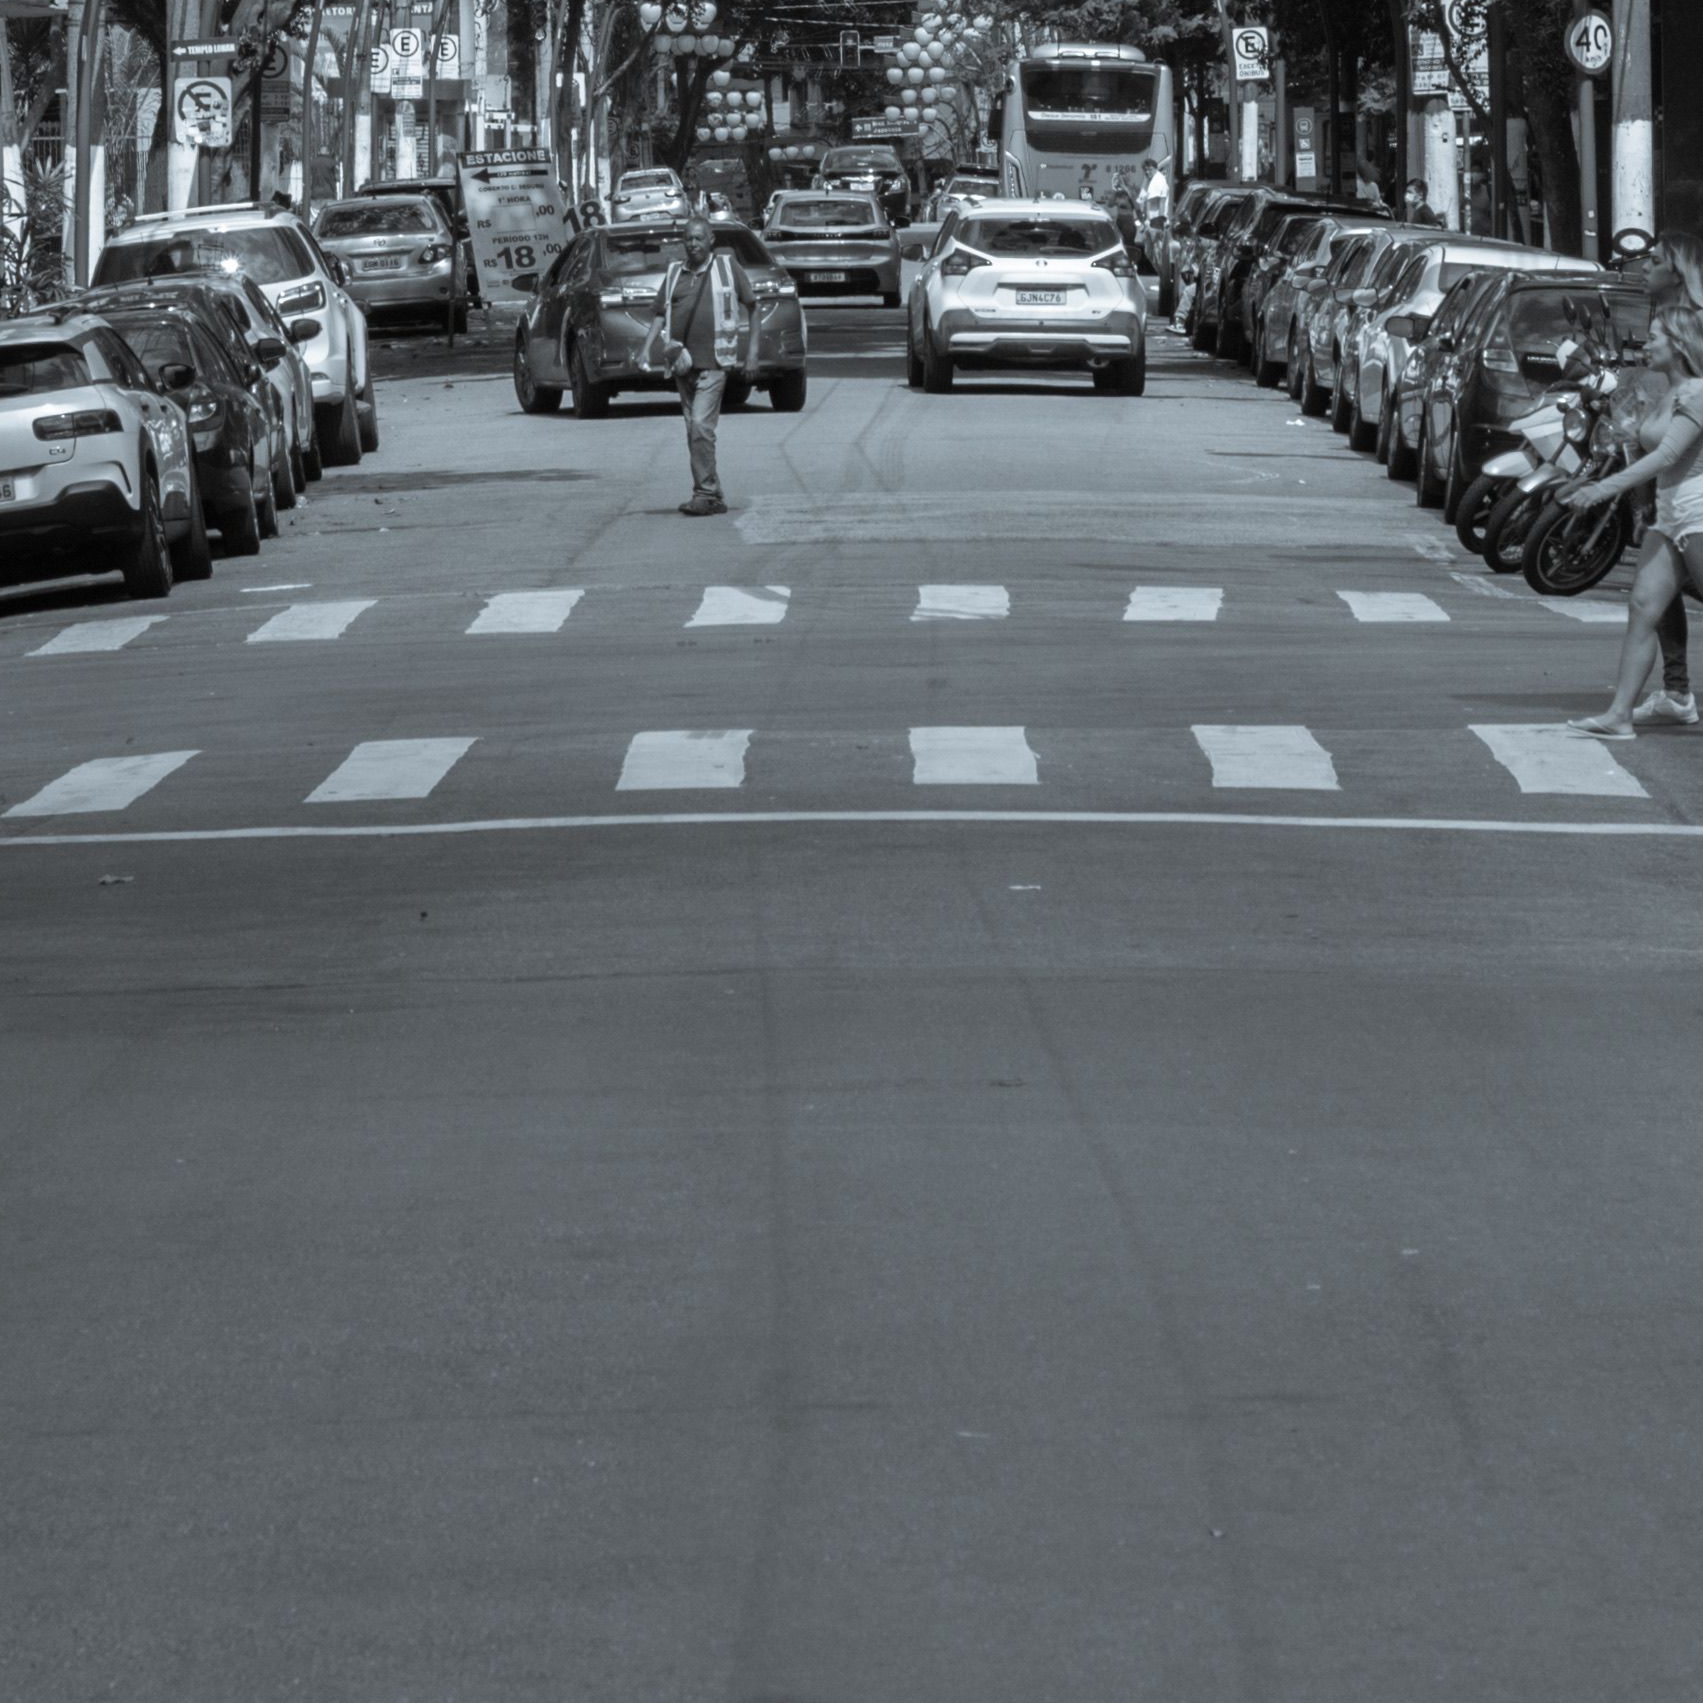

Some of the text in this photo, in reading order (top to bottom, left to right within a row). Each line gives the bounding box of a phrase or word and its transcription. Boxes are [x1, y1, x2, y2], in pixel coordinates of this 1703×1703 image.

[401, 36, 411, 52] E
[465, 149, 546, 166] ESTACIONE
[507, 195, 532, 204] HORA
[497, 244, 537, 271] 18
